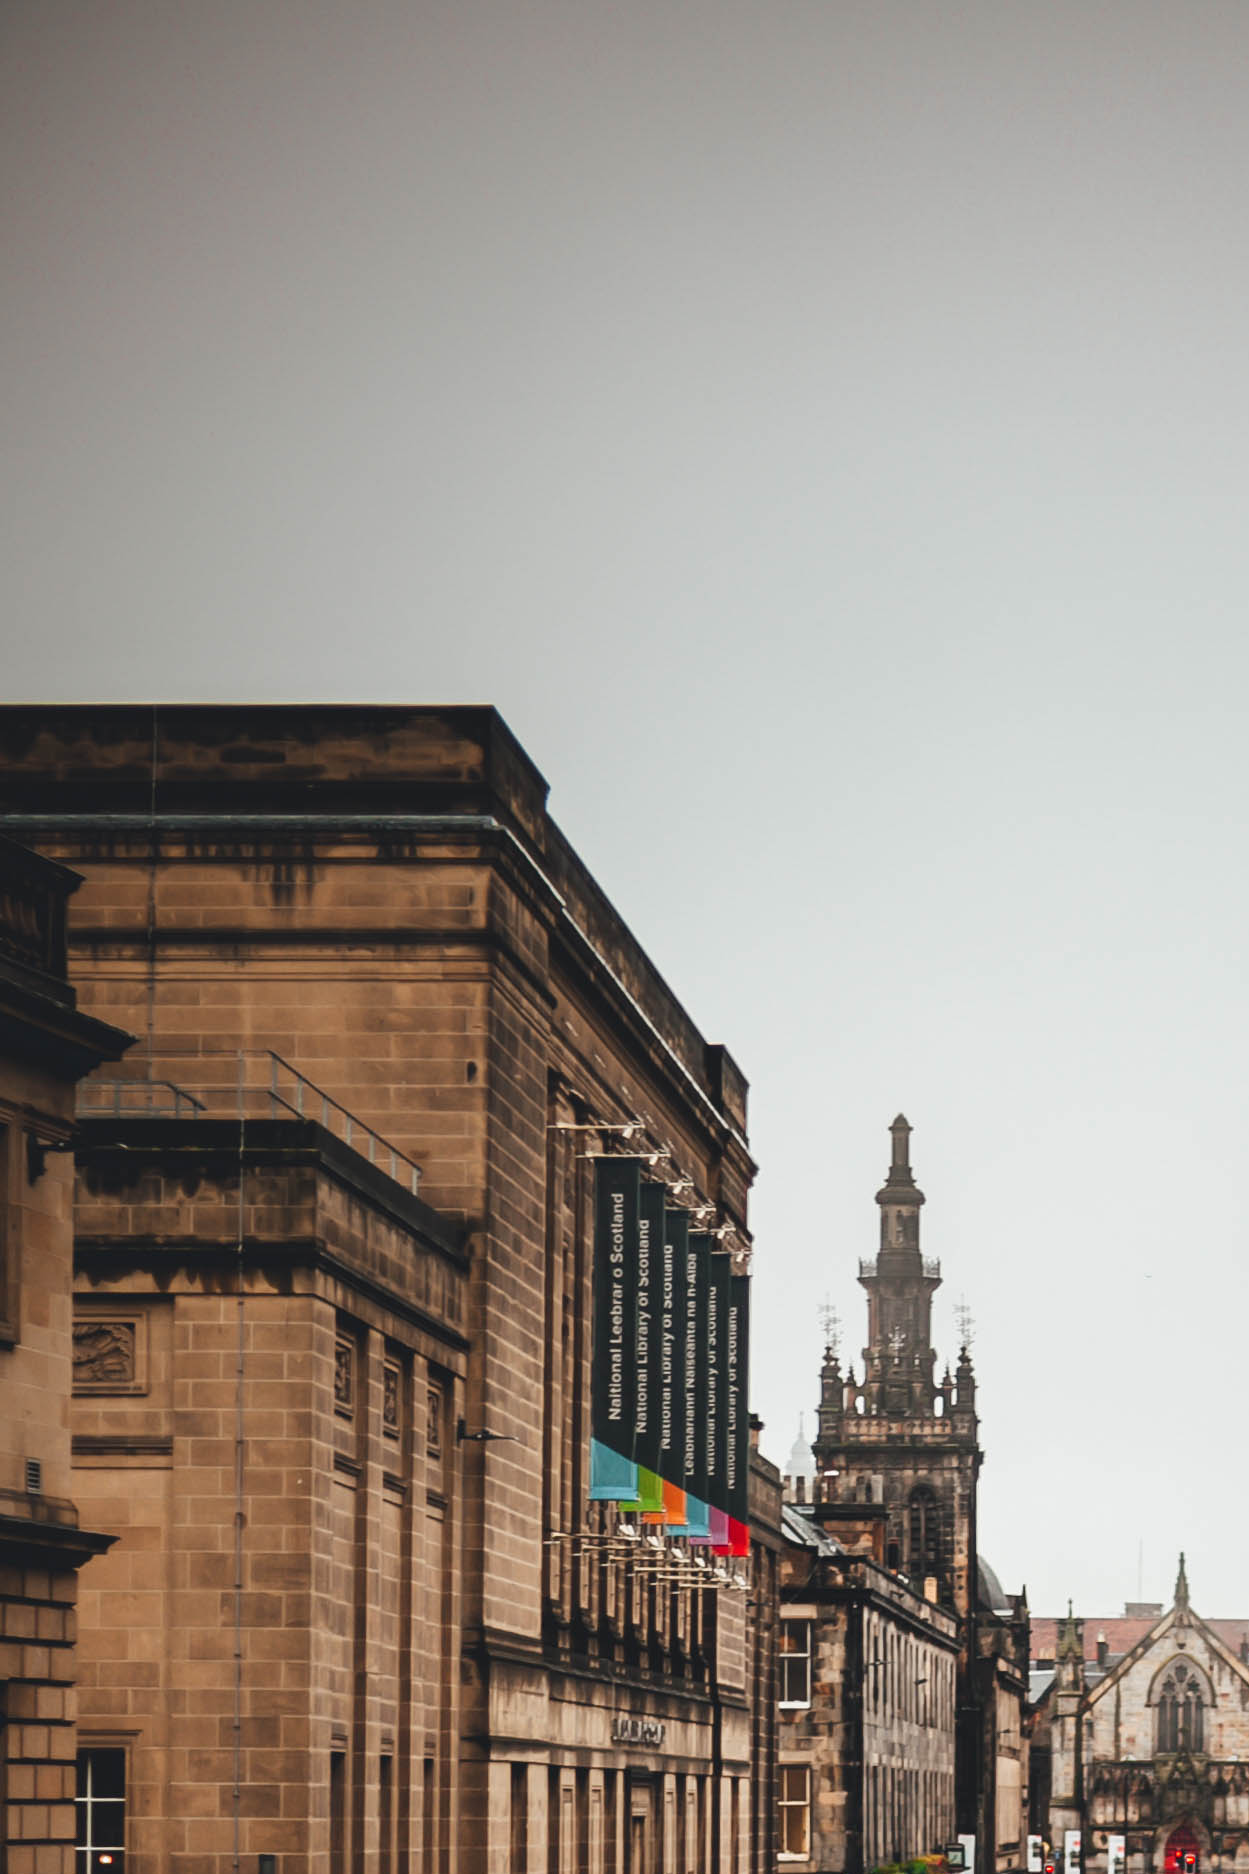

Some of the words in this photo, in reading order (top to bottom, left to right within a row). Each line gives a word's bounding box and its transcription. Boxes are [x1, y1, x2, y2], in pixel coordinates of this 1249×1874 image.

[610, 1193, 624, 1263] Scotland
[638, 1219, 650, 1287] Scotland
[612, 1267, 623, 1279] o
[638, 1291, 649, 1306] of
[609, 1281, 623, 1344] Leebrar
[637, 1310, 652, 1365] Library
[608, 1348, 622, 1420] Naitional
[636, 1368, 648, 1433] National
